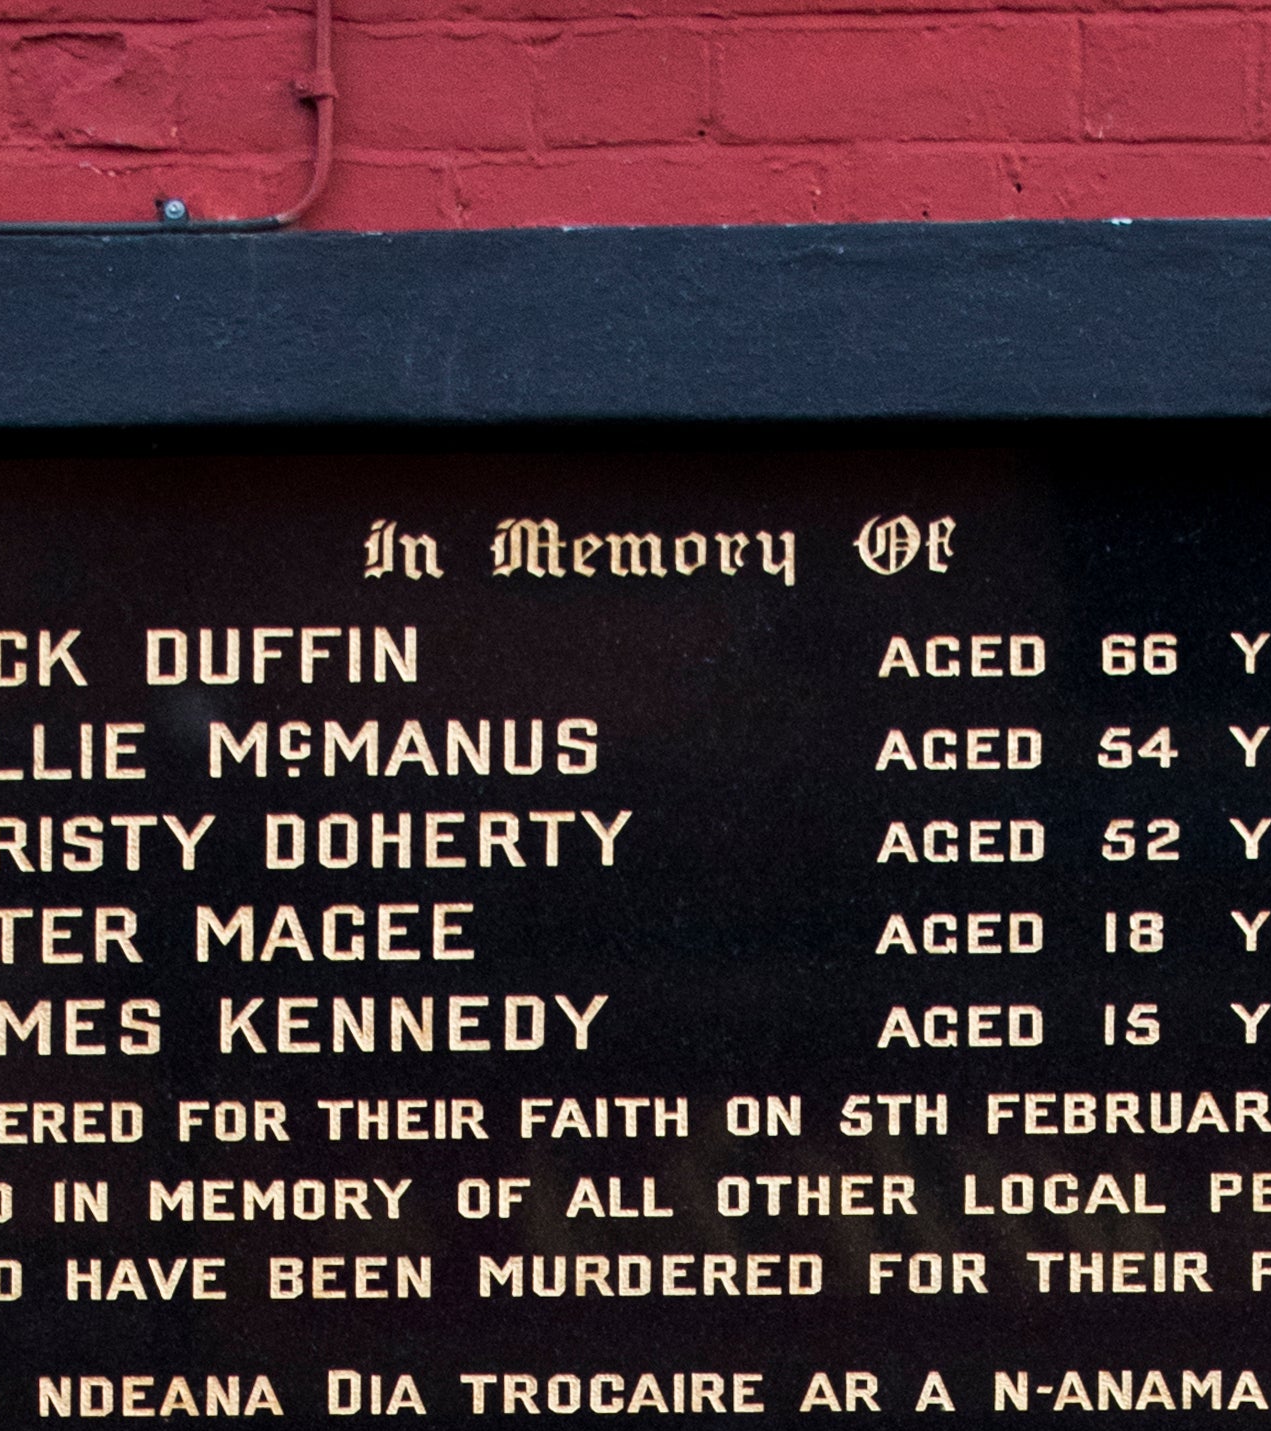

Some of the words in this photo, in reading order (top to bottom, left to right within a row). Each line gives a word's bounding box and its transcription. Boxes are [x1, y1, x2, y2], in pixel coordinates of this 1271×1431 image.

[364, 520, 444, 580] In
[490, 519, 795, 586] Memory
[853, 515, 956, 575] Of
[147, 626, 416, 685] DUFFIN
[879, 635, 1045, 677] AGED
[1102, 634, 1177, 675] 66
[210, 718, 597, 778] McMANUS
[876, 728, 1041, 770] AGED
[1098, 727, 1178, 768] 54
[266, 810, 632, 869] DOHERTY
[877, 820, 1044, 862] AGED
[1102, 819, 1179, 860] 52
[197, 903, 474, 962] MAGEE
[876, 913, 1043, 954] AGED
[1106, 912, 1163, 952] 18
[220, 995, 608, 1053] KENNEDY
[878, 1005, 1043, 1048] AGED
[1105, 1004, 1160, 1045] 15
[179, 1100, 289, 1141] FOR
[318, 1099, 488, 1140] THEIR
[521, 1097, 688, 1138] FAITH
[727, 1095, 801, 1136] ON
[840, 1094, 947, 1136] 5TH
[54, 1181, 108, 1222] IN
[150, 1178, 412, 1221] MEMORY
[458, 1178, 530, 1218] OF
[566, 1177, 673, 1217] ALL
[718, 1175, 917, 1216] OTHER
[965, 1173, 1166, 1214] LOCAL
[67, 1258, 226, 1300] HAVE
[270, 1256, 431, 1299] BEEN
[480, 1254, 822, 1297] MURDERED
[870, 1253, 988, 1294] FOR
[1027, 1252, 1213, 1292] THEIR
[39, 1375, 283, 1417] NDEANA
[460, 1373, 764, 1414] TROCAIRE
[800, 1372, 881, 1412] AR
[916, 1371, 955, 1411] A
